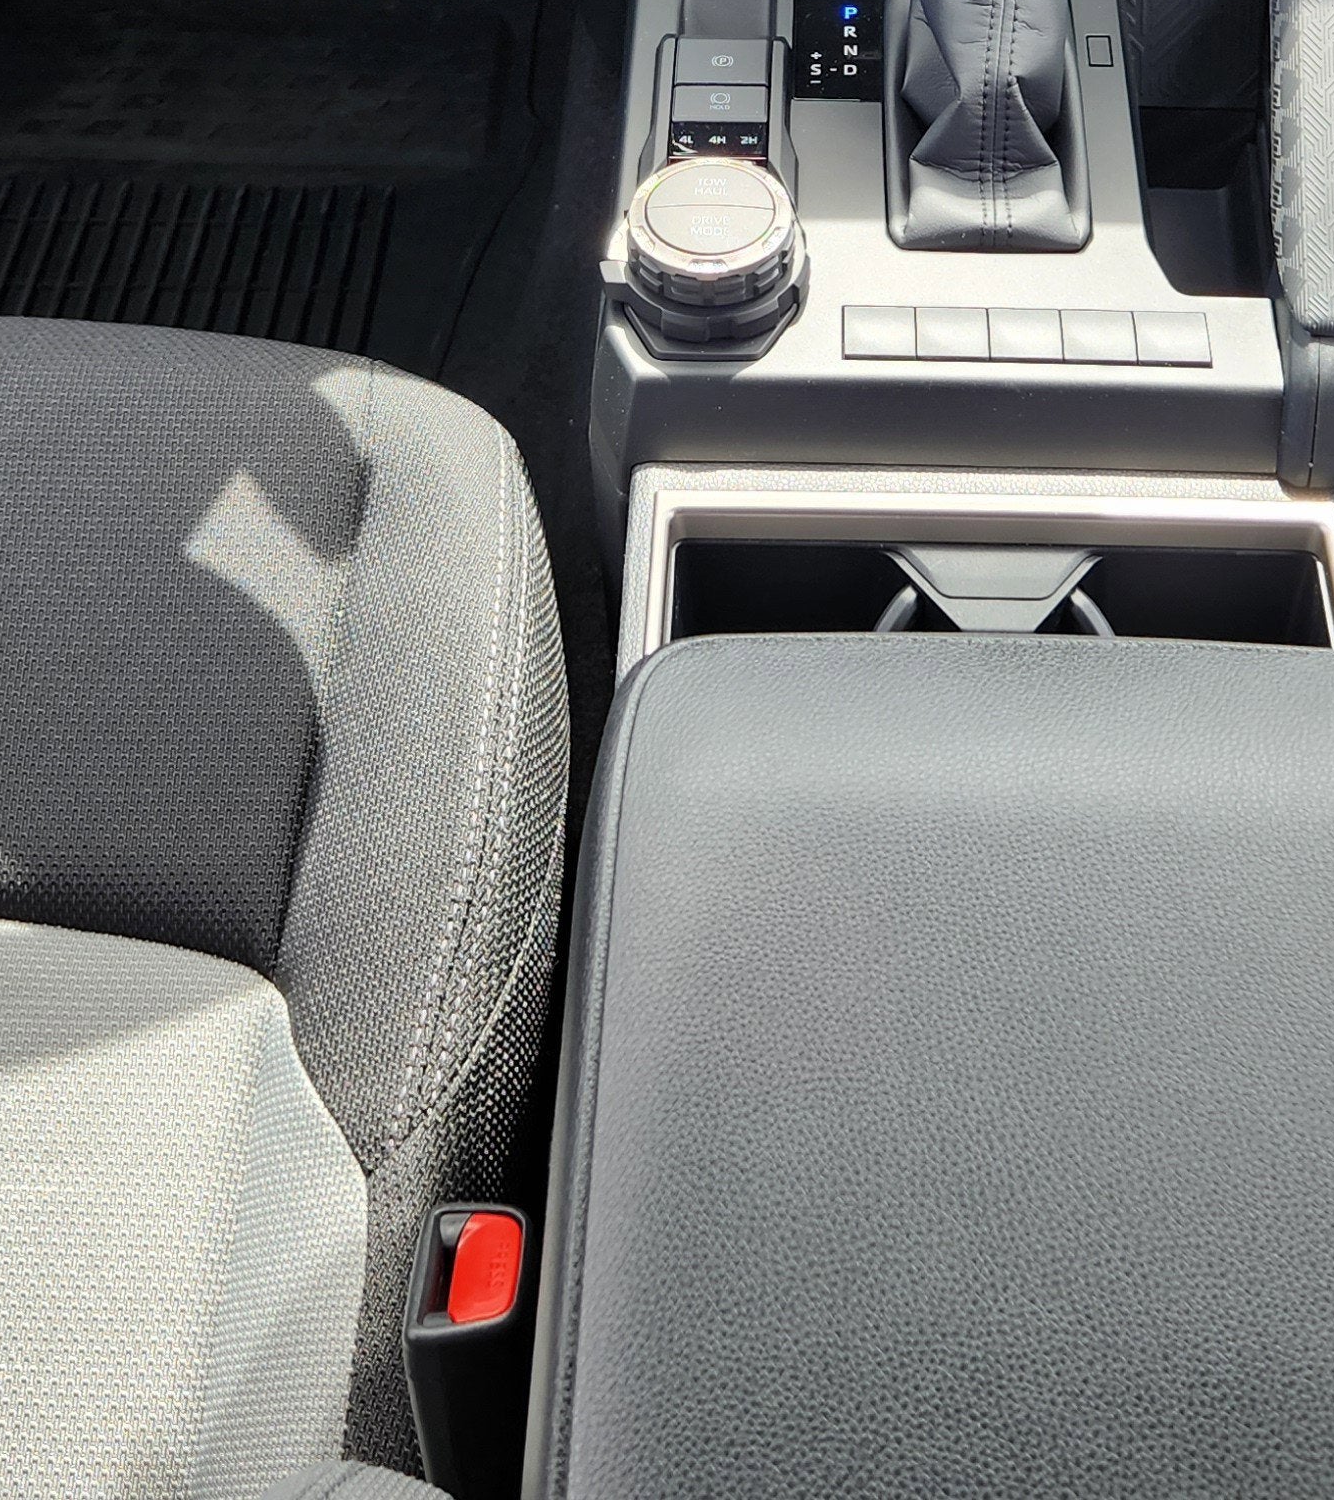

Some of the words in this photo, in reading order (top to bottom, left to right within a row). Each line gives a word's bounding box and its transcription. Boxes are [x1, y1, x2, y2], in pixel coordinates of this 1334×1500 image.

[844, 6, 858, 19] P
[843, 25, 858, 38] R
[843, 44, 858, 56] N
[809, 63, 822, 76] S
[843, 64, 858, 76] D
[678, 135, 694, 145] 4L
[708, 135, 727, 145] 4H
[739, 135, 759, 145] 2H
[698, 178, 727, 187] TOW
[694, 186, 729, 196] HAUL
